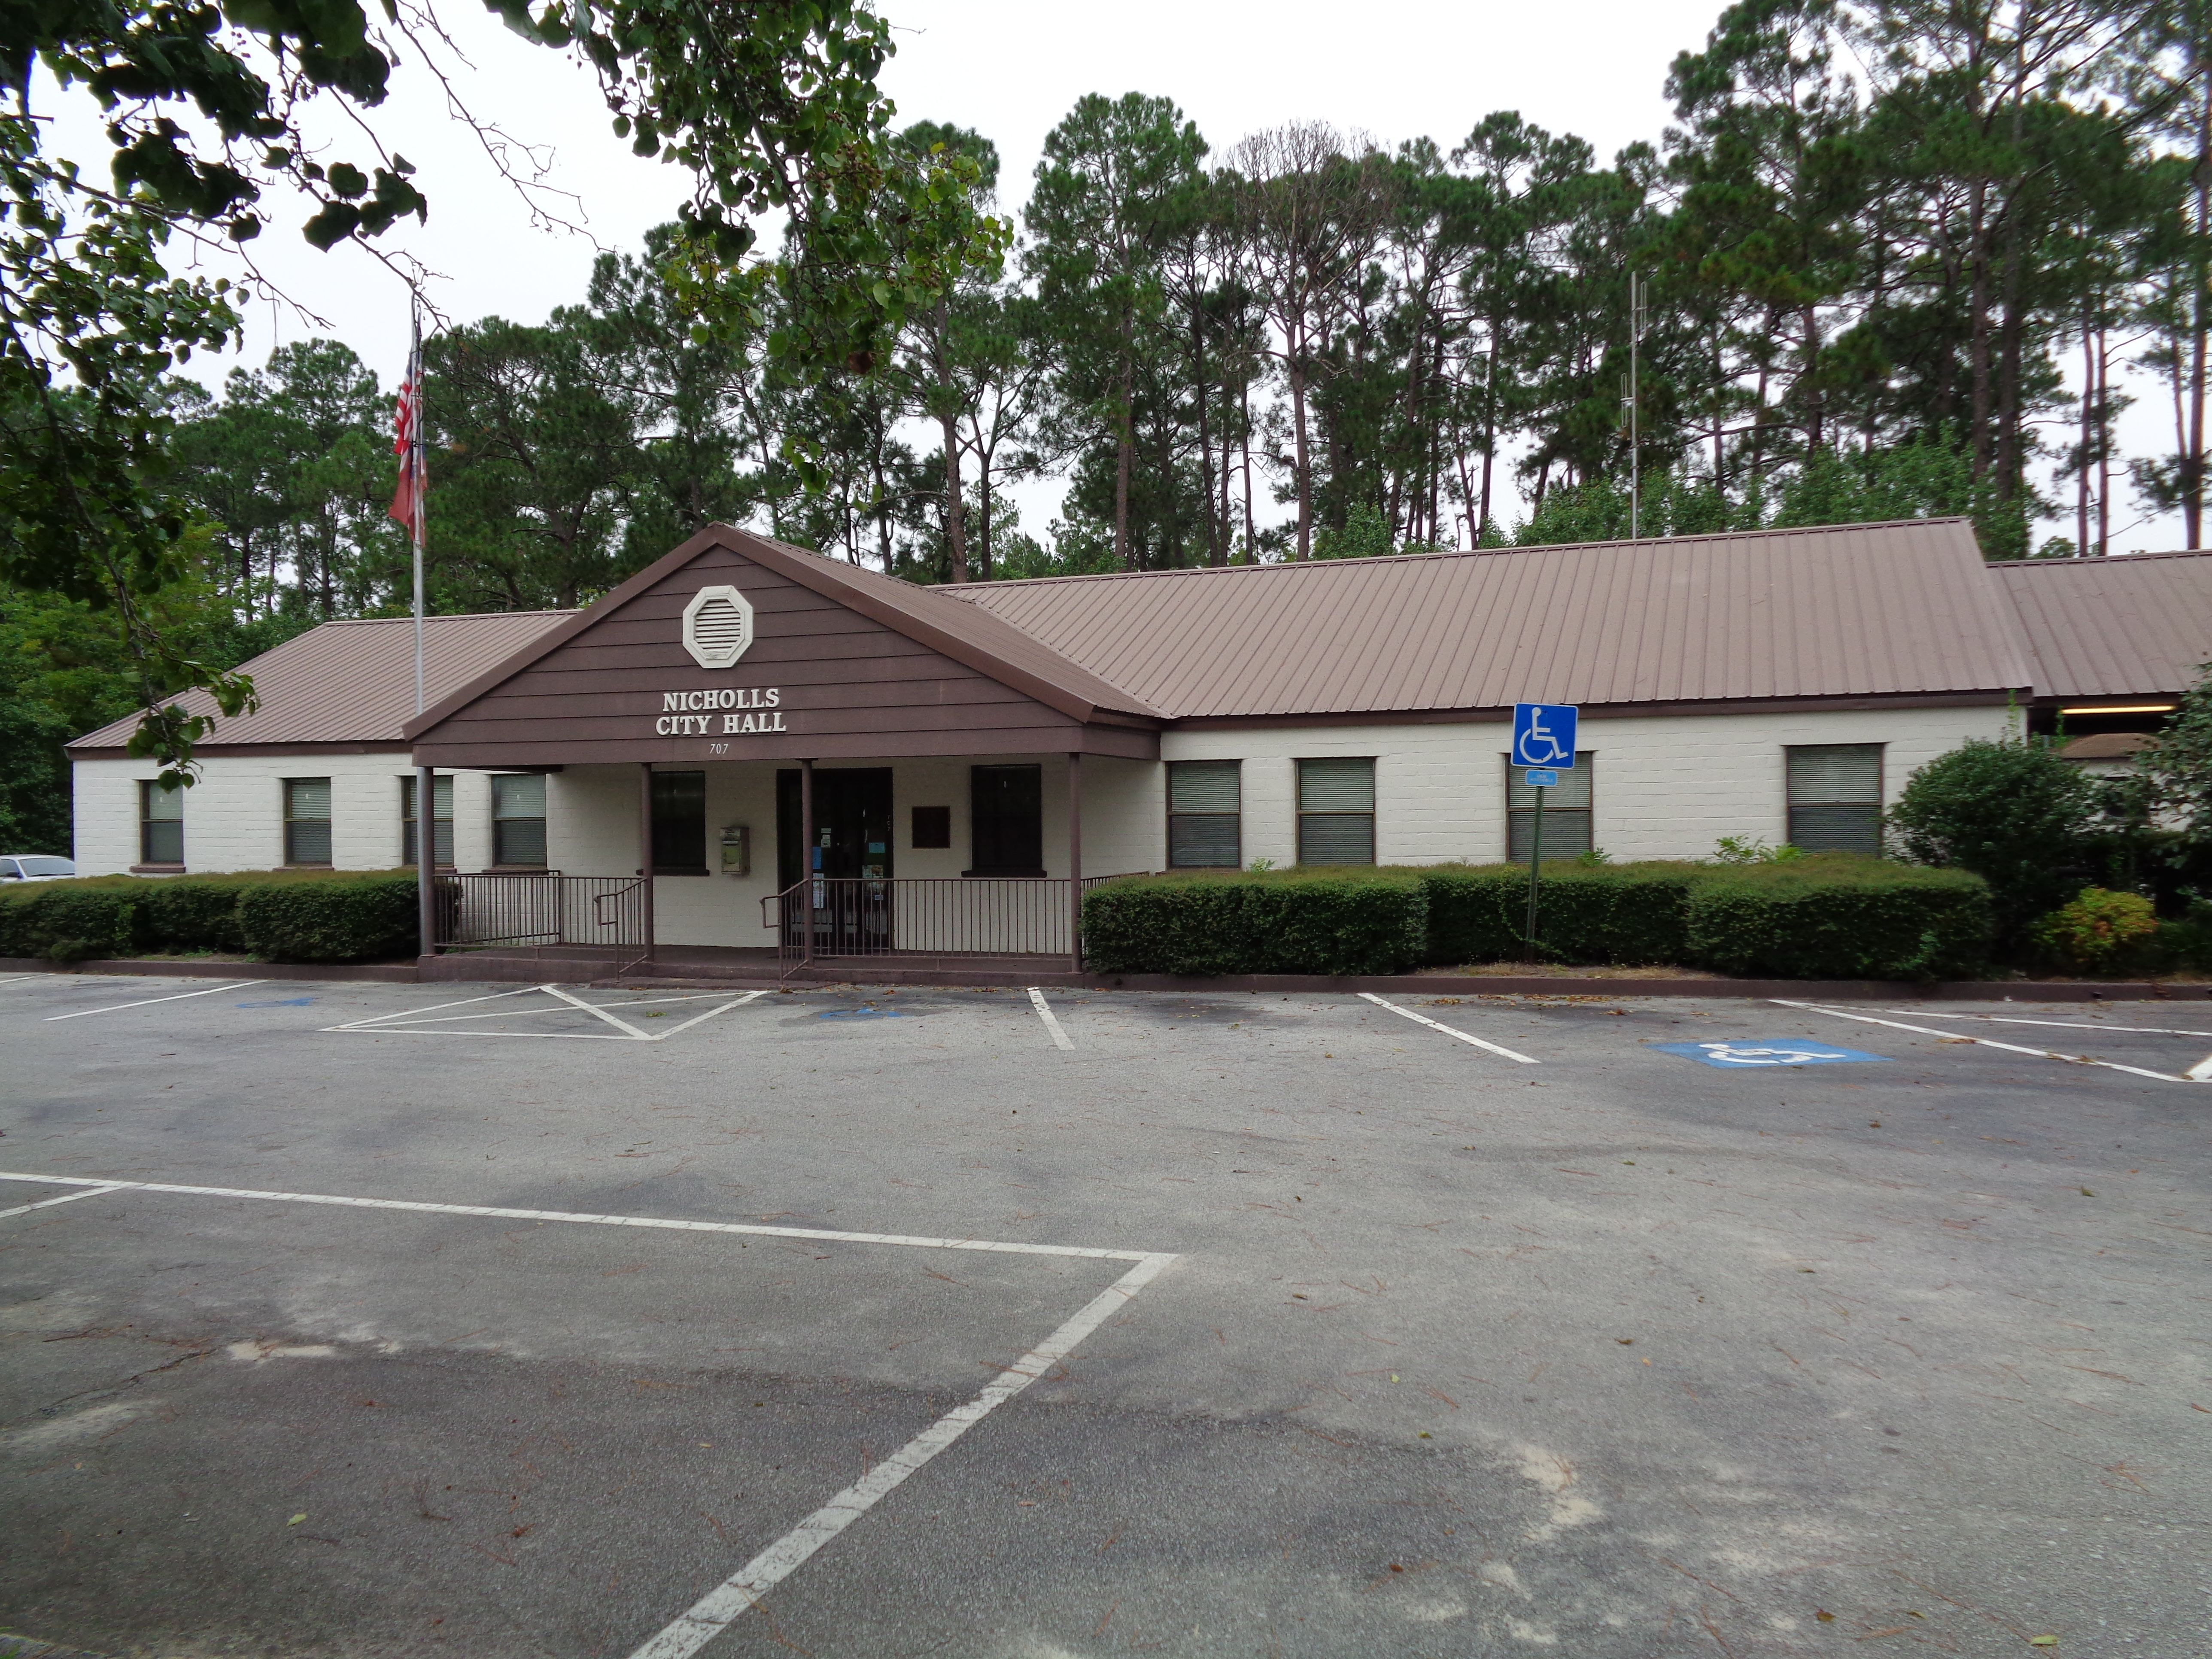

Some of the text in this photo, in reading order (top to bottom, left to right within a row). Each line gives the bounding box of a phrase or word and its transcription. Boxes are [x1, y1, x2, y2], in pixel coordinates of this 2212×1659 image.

[662, 688, 780, 712] NICHOLLS
[656, 713, 787, 735] CITY HALL
[709, 743, 729, 754] 707
